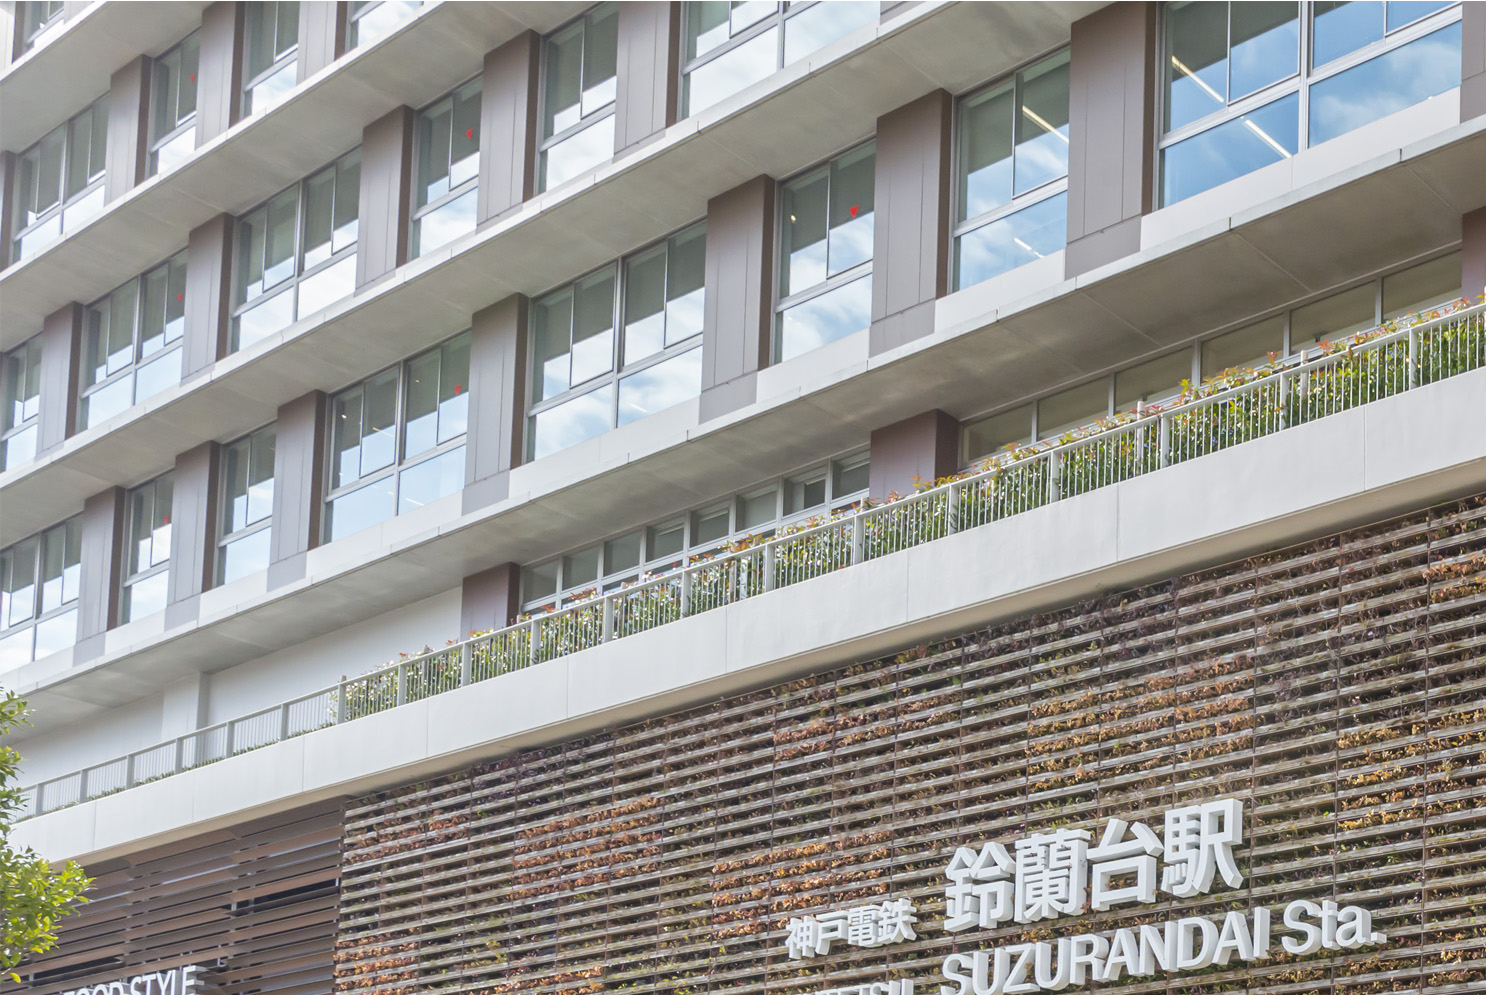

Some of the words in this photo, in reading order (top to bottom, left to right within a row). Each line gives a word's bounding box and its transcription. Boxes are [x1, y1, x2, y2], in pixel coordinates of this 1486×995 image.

[944, 798, 1243, 932] 鈴蘭台駅
[785, 897, 918, 959] 神戸電鉄
[1281, 899, 1387, 956] Sta.
